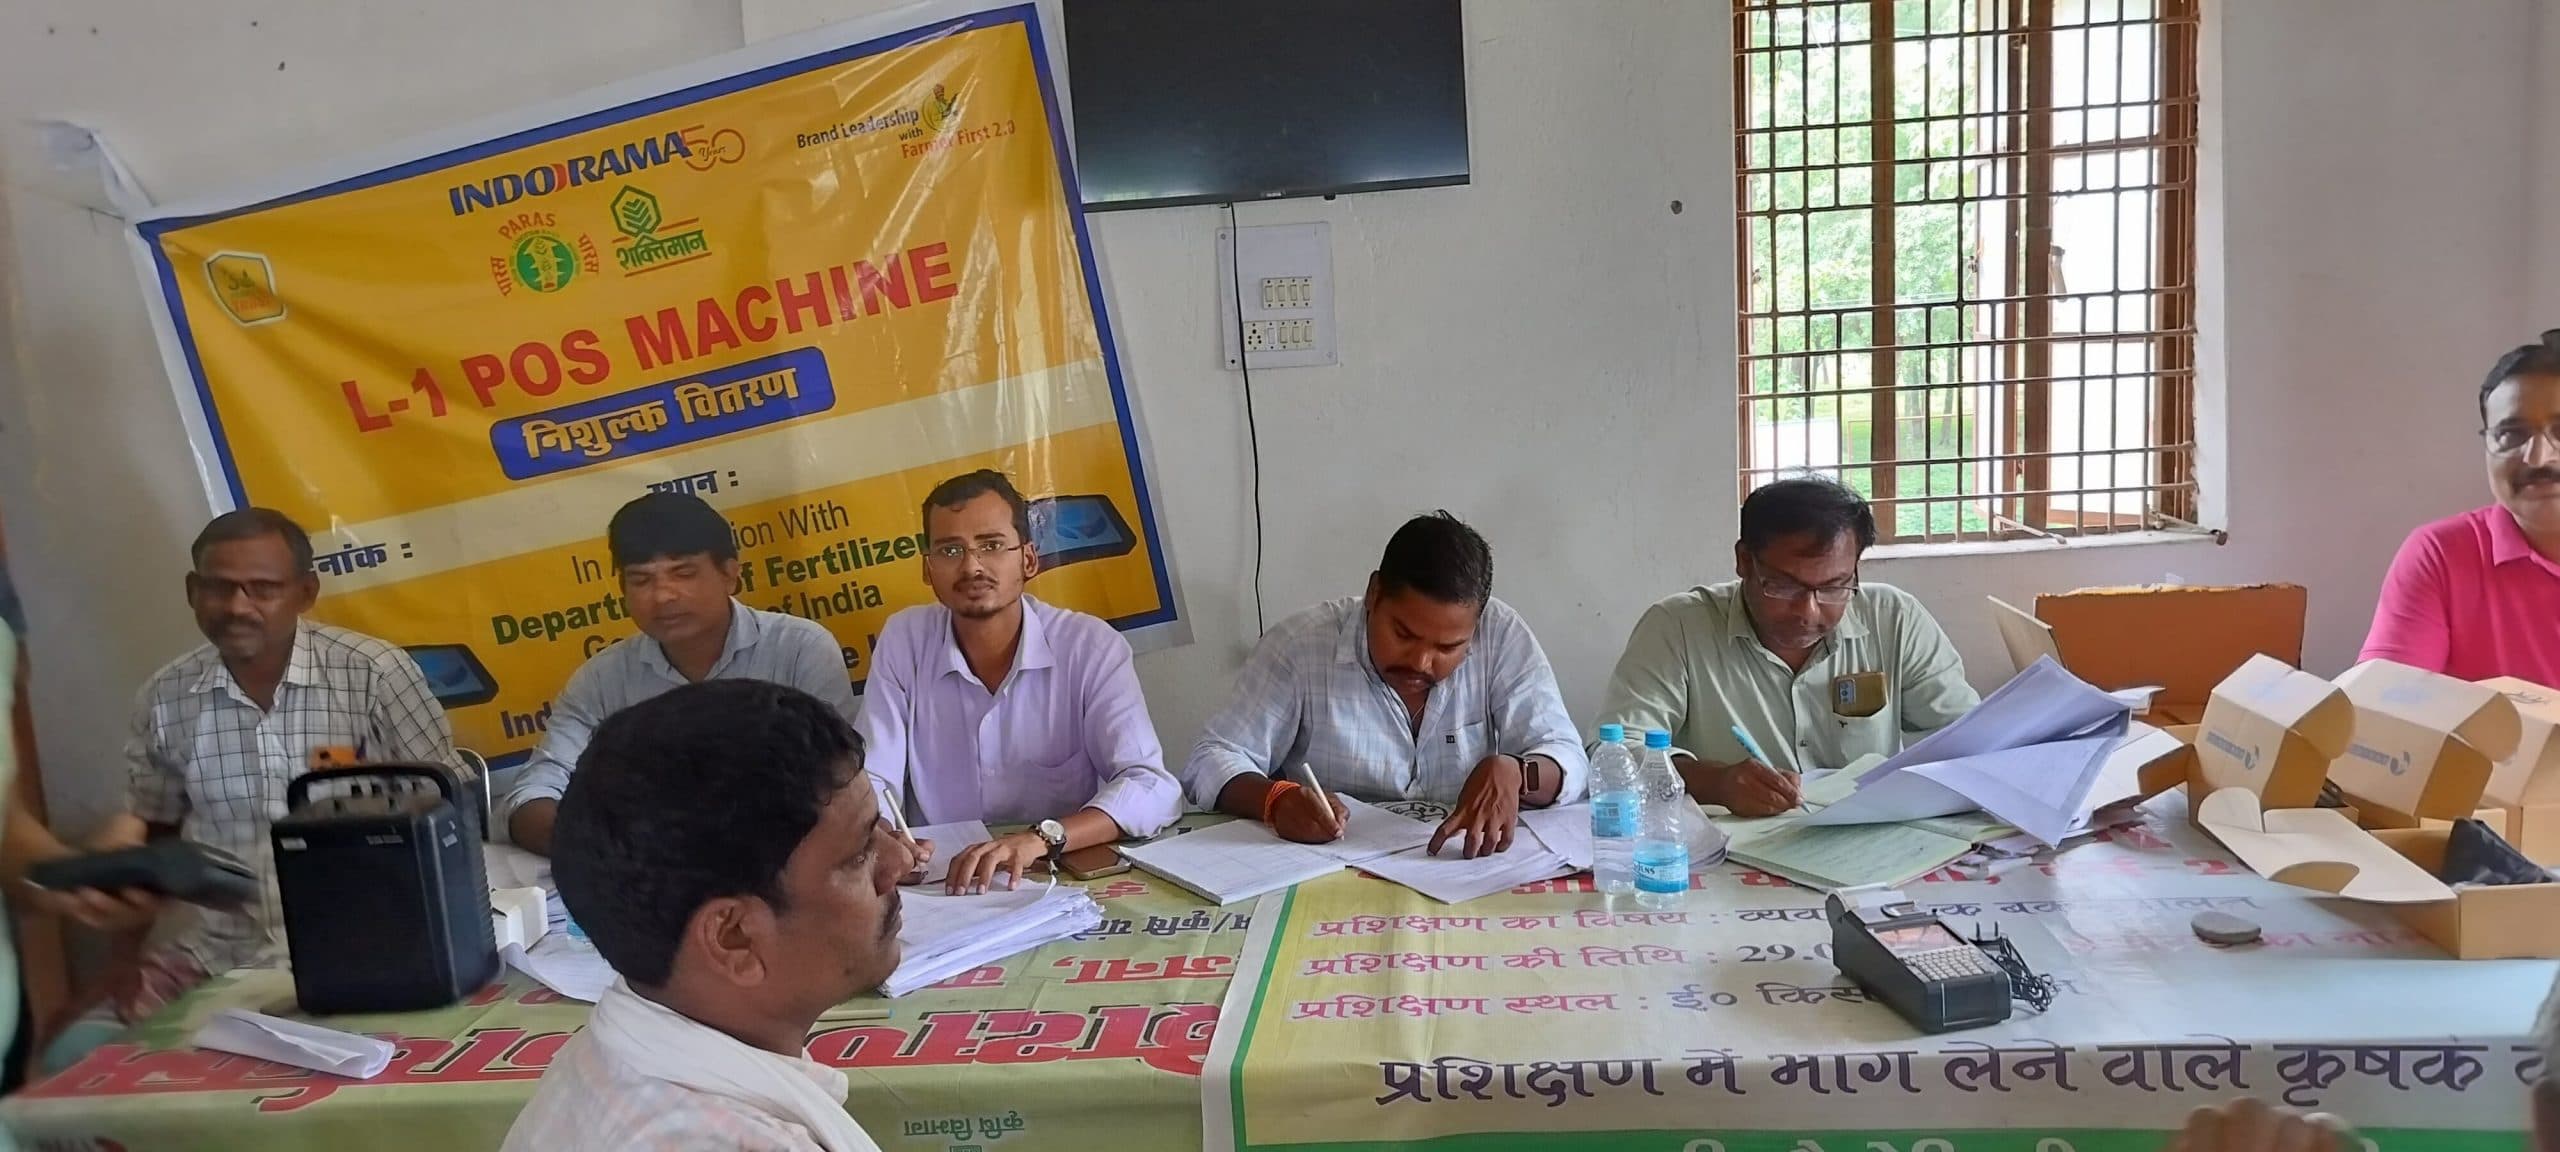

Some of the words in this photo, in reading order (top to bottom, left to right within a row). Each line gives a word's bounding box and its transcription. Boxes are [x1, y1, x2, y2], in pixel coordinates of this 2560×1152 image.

[796, 125, 840, 149] Brand
[841, 107, 920, 139] Leadership
[898, 127, 924, 142] with
[498, 211, 557, 241] PARAS
[340, 367, 448, 433] L-1
[460, 328, 610, 408] POS
[624, 241, 959, 371] MACHINE
[520, 396, 668, 458] निशुल्क
[673, 367, 799, 425] वितरण
[571, 555, 602, 585] In
[778, 500, 849, 540] With
[800, 581, 884, 620] India
[1312, 915, 1490, 937] प्रशिक्षण
[1500, 915, 1561, 930] का
[1572, 909, 1690, 929] विषय
[1303, 952, 1489, 977] प्रशिक्षण
[1501, 946, 1568, 970] की
[1579, 944, 1689, 968] तिथि
[1291, 994, 1491, 1020] प्रशिक्षण
[1504, 993, 1619, 1014] स्थल
[1375, 1055, 1664, 1107] प्रशिक्षण
[1681, 1048, 1747, 1095] में
[1938, 1038, 2079, 1092] लेने
[2095, 1033, 2252, 1092] वाले
[904, 1118, 973, 1142] विभाग
[979, 1111, 1025, 1141] कृषि
